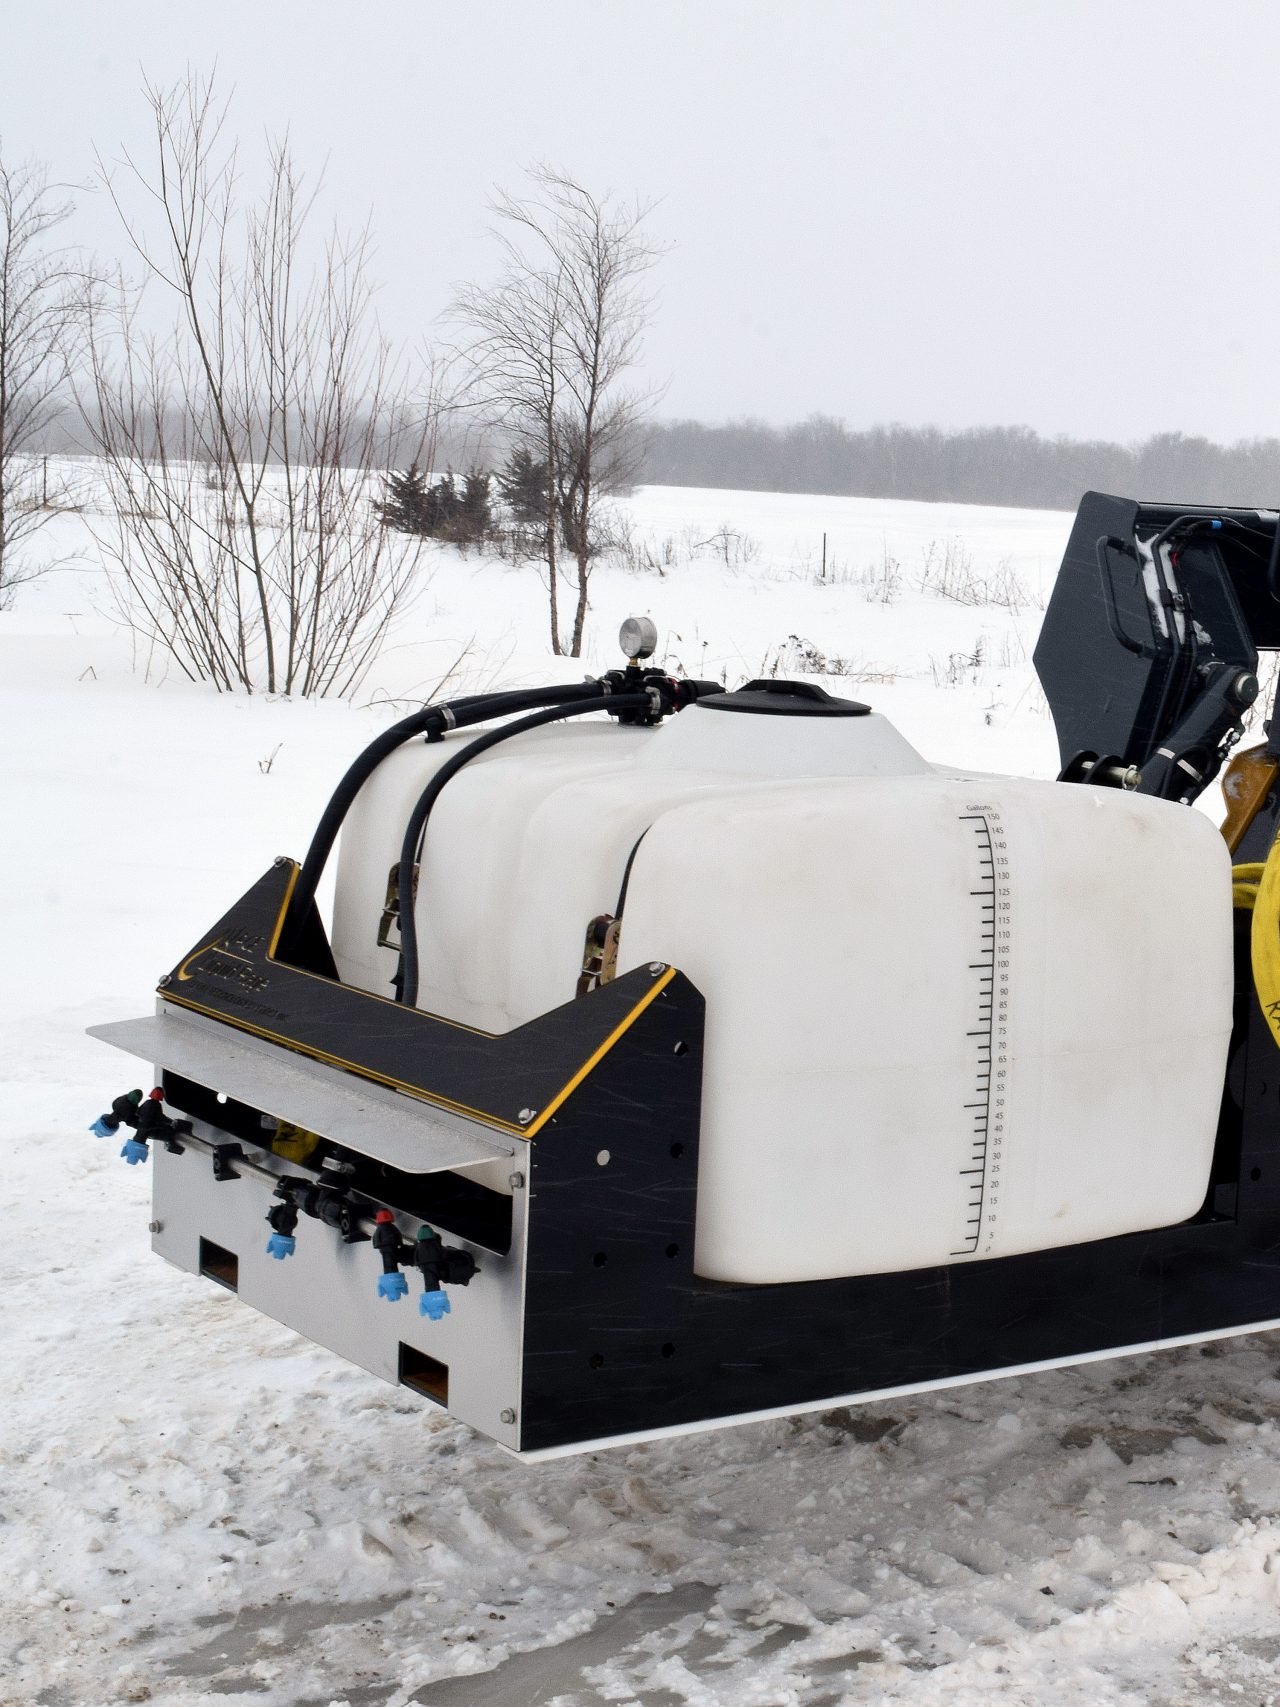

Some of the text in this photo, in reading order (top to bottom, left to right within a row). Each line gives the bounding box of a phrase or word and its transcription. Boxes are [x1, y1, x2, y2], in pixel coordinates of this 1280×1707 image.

[992, 826, 1004, 834] 145
[998, 931, 1010, 939] 110
[1000, 974, 1008, 982] 95
[1000, 988, 1008, 996] 90
[998, 1014, 1007, 1022] 80
[998, 1042, 1006, 1050] 70
[997, 1070, 1006, 1078] 60
[996, 1084, 1005, 1092] 55
[995, 1112, 1004, 1120] 45
[994, 1125, 1003, 1133] 40
[992, 1152, 1001, 1160] 30
[990, 1197, 998, 1205] 15
[988, 1214, 996, 1222] 10
